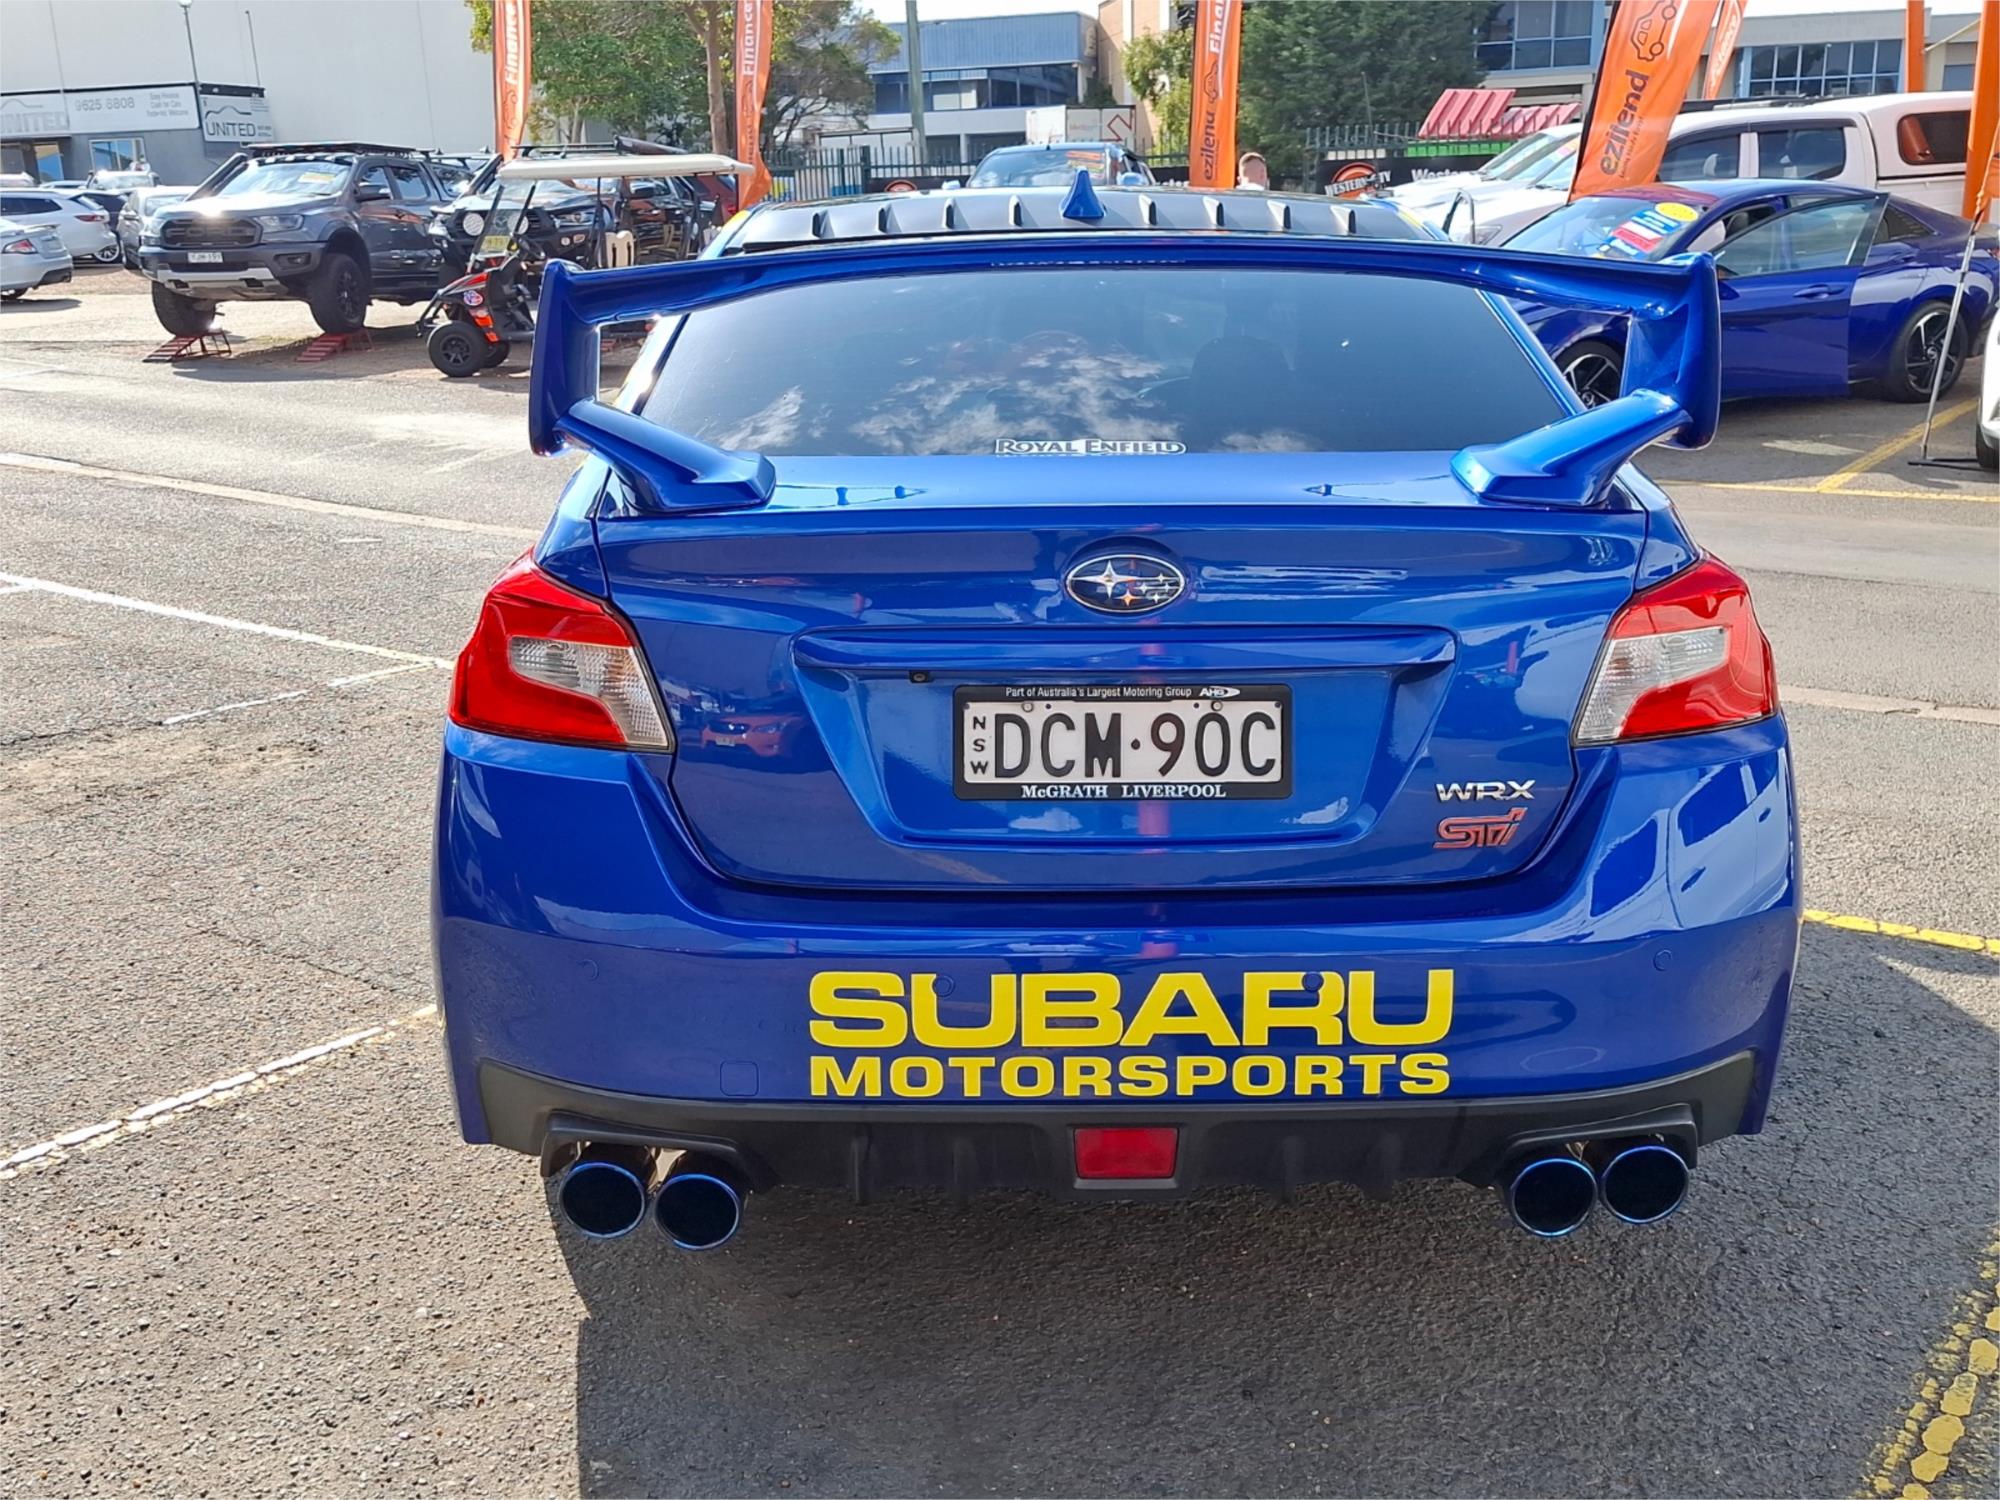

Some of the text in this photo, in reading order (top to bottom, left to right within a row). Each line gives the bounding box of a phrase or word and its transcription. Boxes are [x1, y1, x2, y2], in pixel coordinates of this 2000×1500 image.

[205, 121, 256, 137] UNITED
[1599, 69, 1649, 175] ezilend
[995, 438, 1186, 454] ROYAL ENFIELD
[1005, 686, 1025, 698] Part
[1026, 686, 1037, 698] of
[1038, 686, 1085, 698] Australia's
[1086, 686, 1121, 699] Largest
[1123, 686, 1163, 699] Motoring
[1165, 686, 1192, 699] Group
[1021, 784, 1227, 798] McGRATH LIVERPOOL
[1436, 780, 1536, 801] WRX
[810, 969, 1454, 1048] SUBARU
[811, 1052, 1450, 1098] MOTORSPORTS
